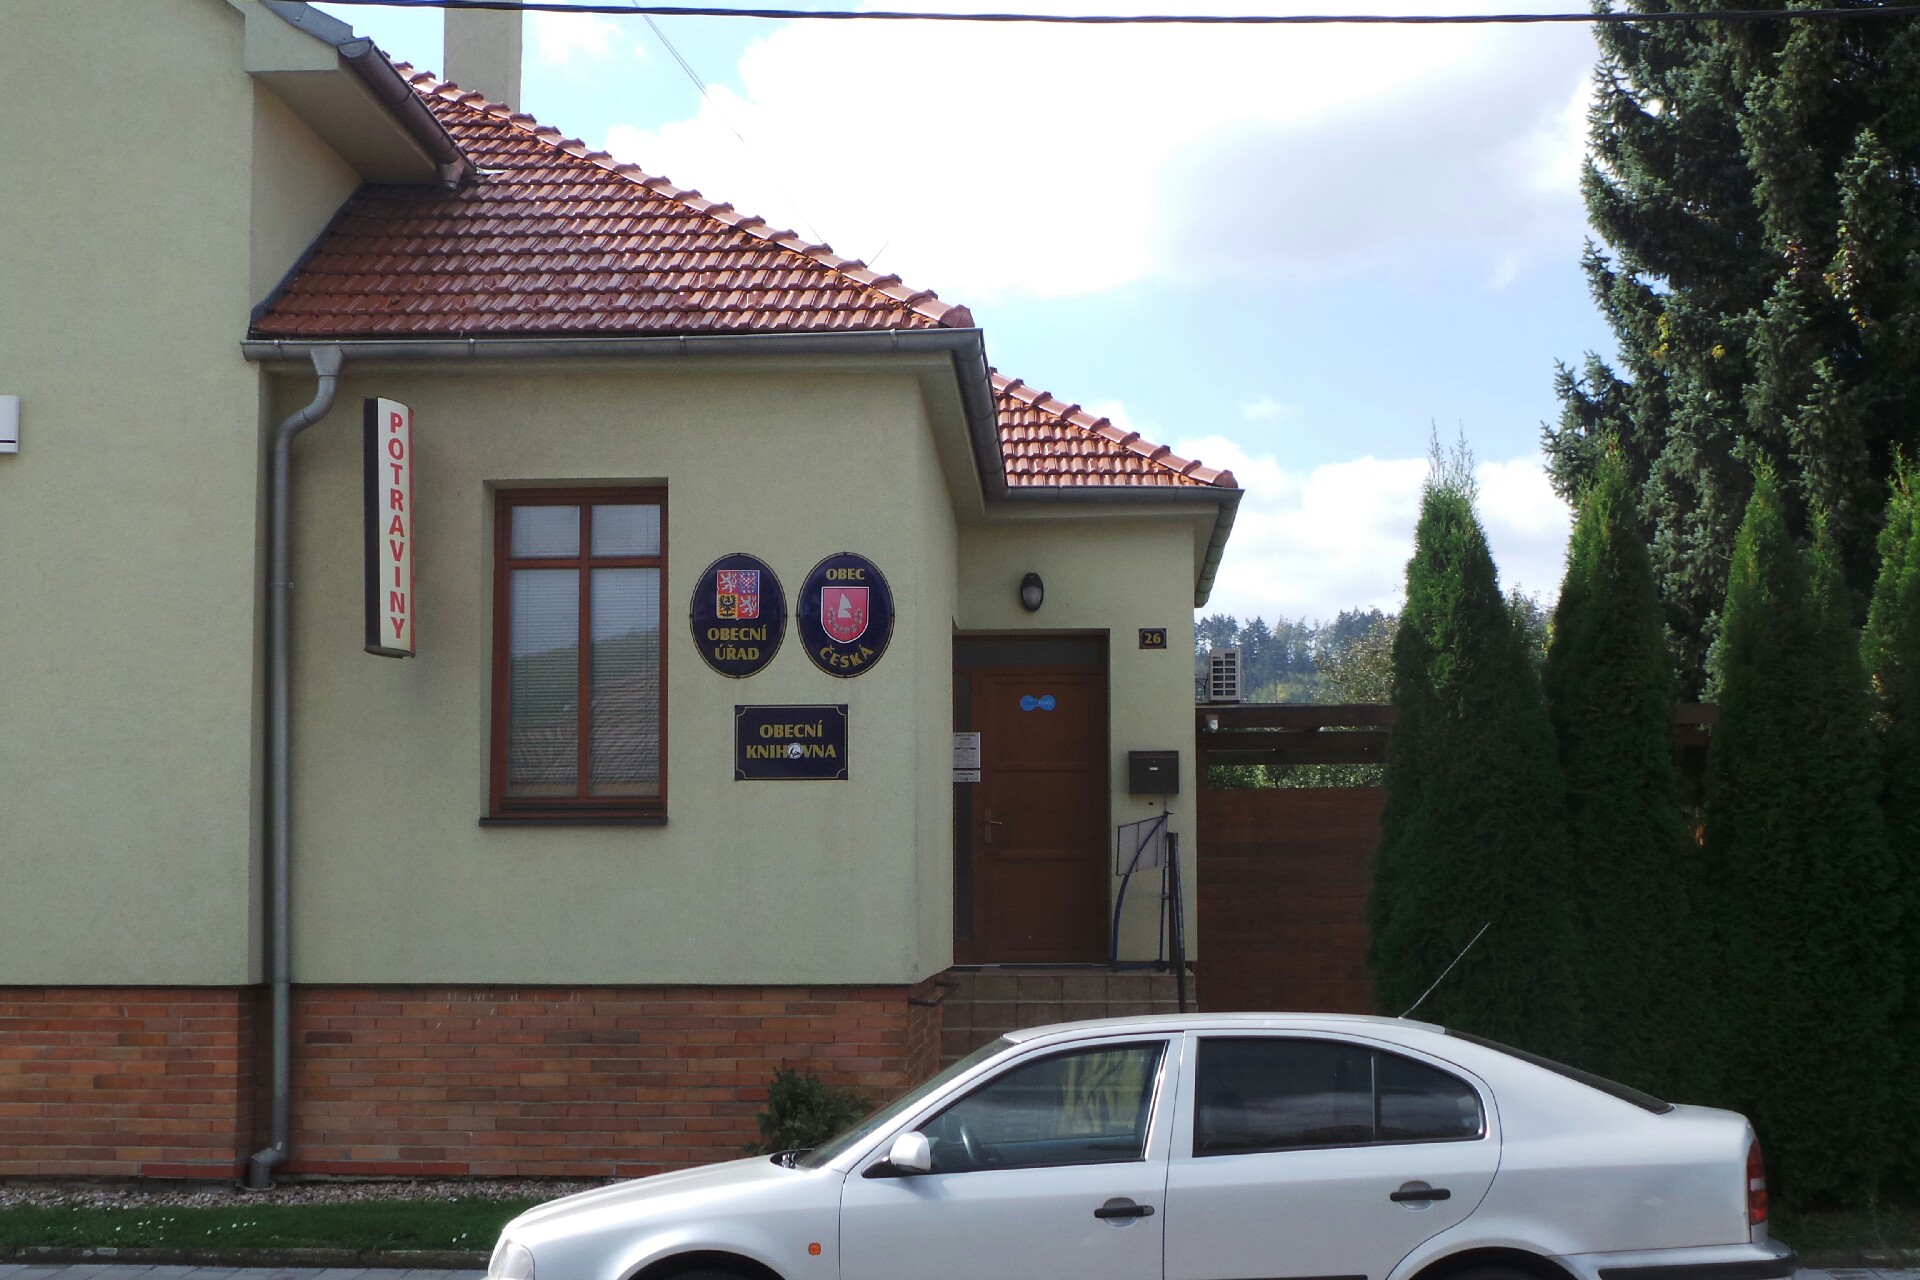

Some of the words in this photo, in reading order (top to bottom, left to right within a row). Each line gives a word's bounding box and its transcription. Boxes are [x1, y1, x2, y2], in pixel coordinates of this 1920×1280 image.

[388, 411, 405, 640] POTRAVINY
[825, 568, 865, 580] OBEC
[707, 626, 767, 641] OBECNÍ
[1144, 633, 1161, 644] 26
[714, 643, 760, 661] ÚŘAD
[818, 643, 874, 669] ČESKÁ
[759, 719, 823, 738] OBECNÍ
[746, 743, 837, 759] KNIHVNA
